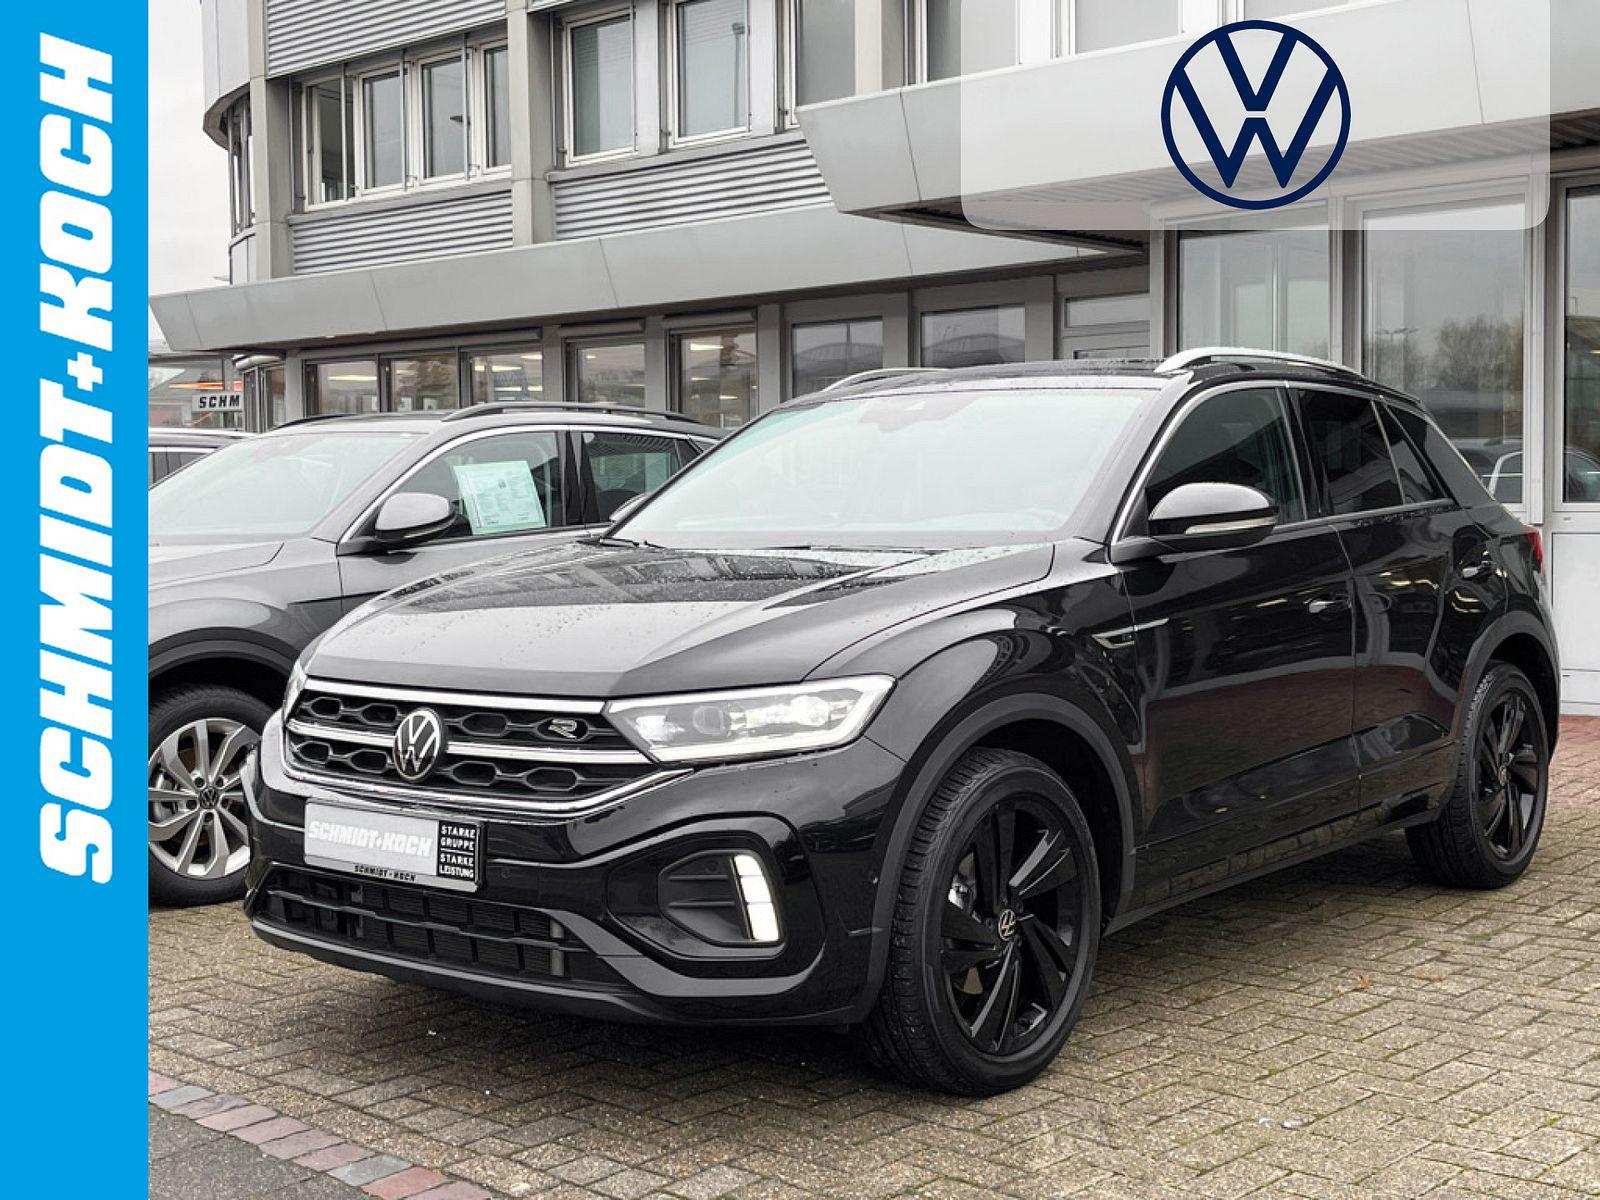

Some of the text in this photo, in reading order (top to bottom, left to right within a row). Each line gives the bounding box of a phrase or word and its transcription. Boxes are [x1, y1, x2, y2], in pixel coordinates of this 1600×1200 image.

[441, 825, 476, 838] STARKE
[308, 821, 433, 857] SCHMIDT+KOCH
[441, 837, 474, 850] GRUPPE
[440, 853, 474, 867] STARKE
[439, 865, 474, 879] LEISTUNG
